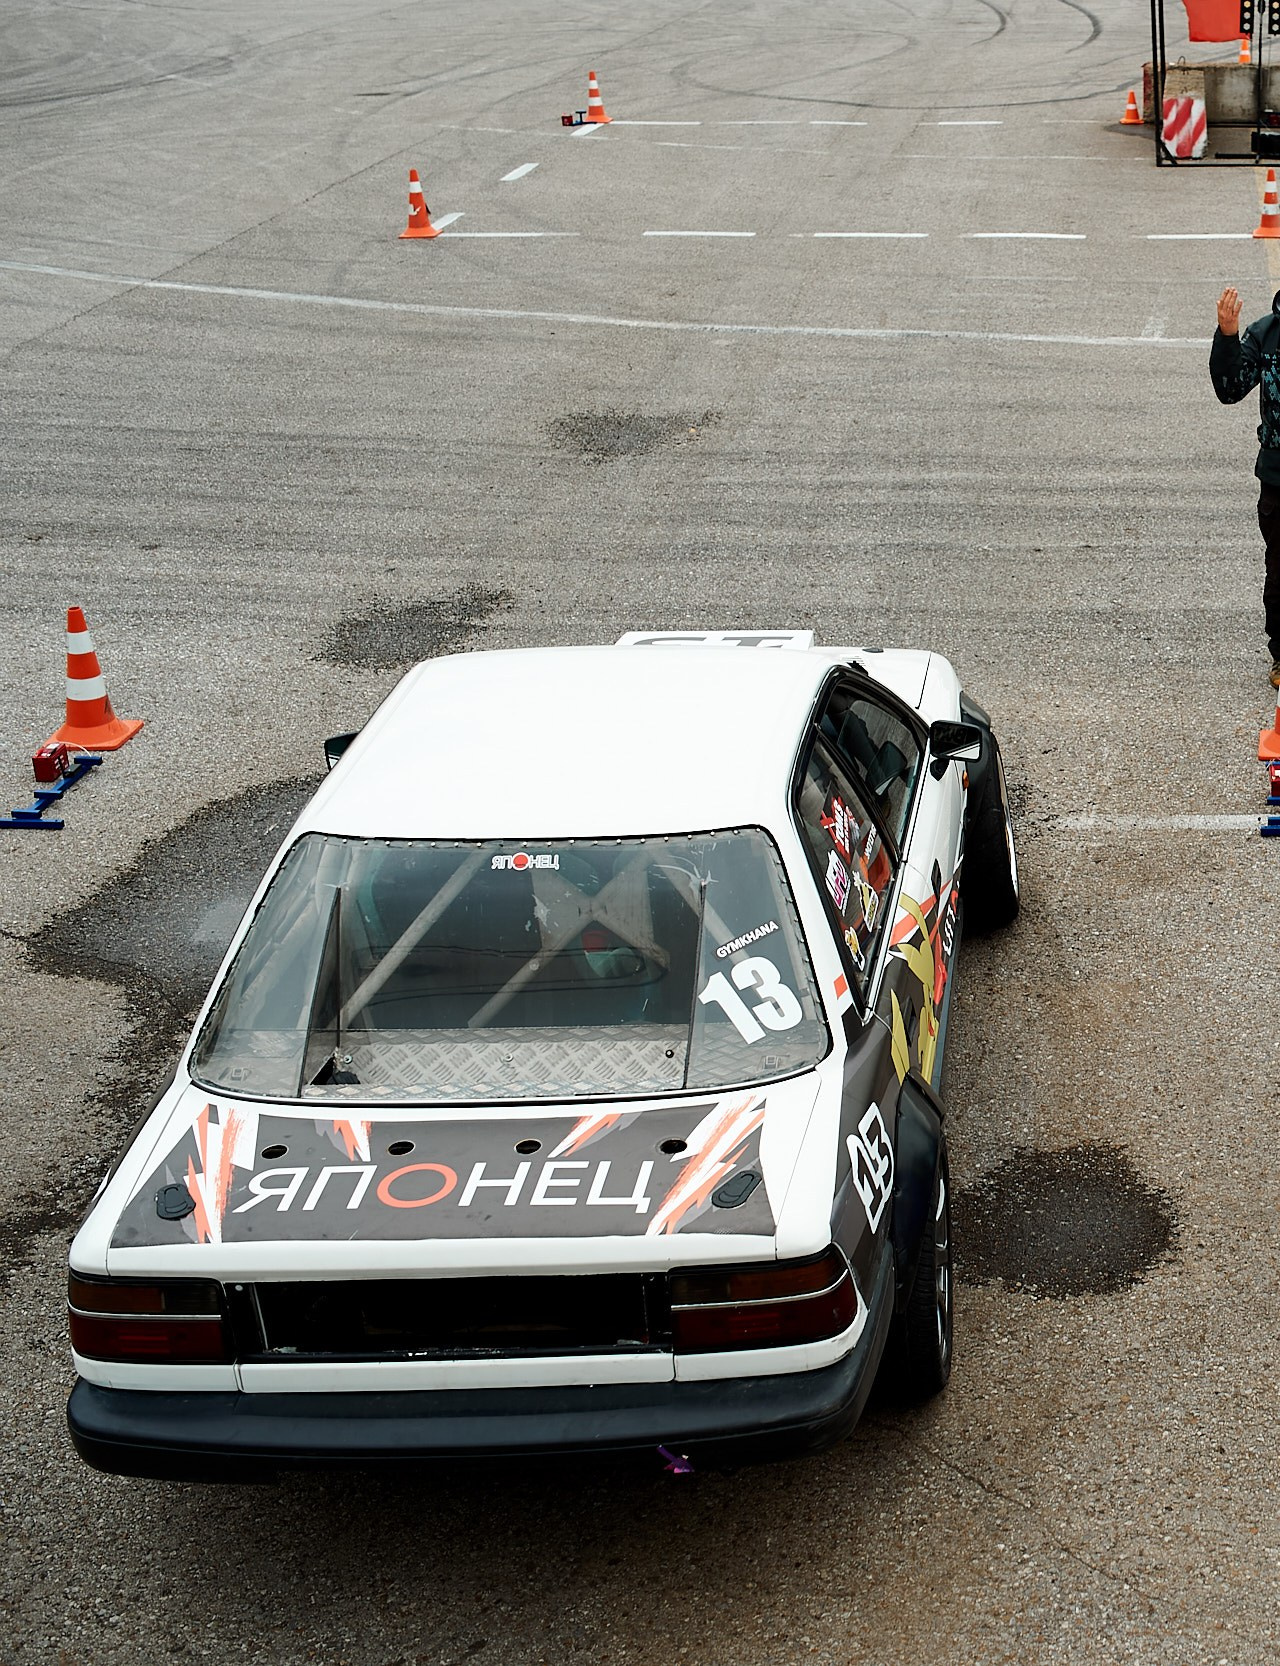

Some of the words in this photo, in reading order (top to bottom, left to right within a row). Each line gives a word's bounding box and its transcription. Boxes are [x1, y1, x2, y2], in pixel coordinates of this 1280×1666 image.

[491, 852, 560, 871] ЯПОНЕЦ
[716, 920, 779, 958] GYMKHANA
[698, 956, 803, 1045] 13
[232, 1160, 654, 1214] ЯПОНЕЦ
